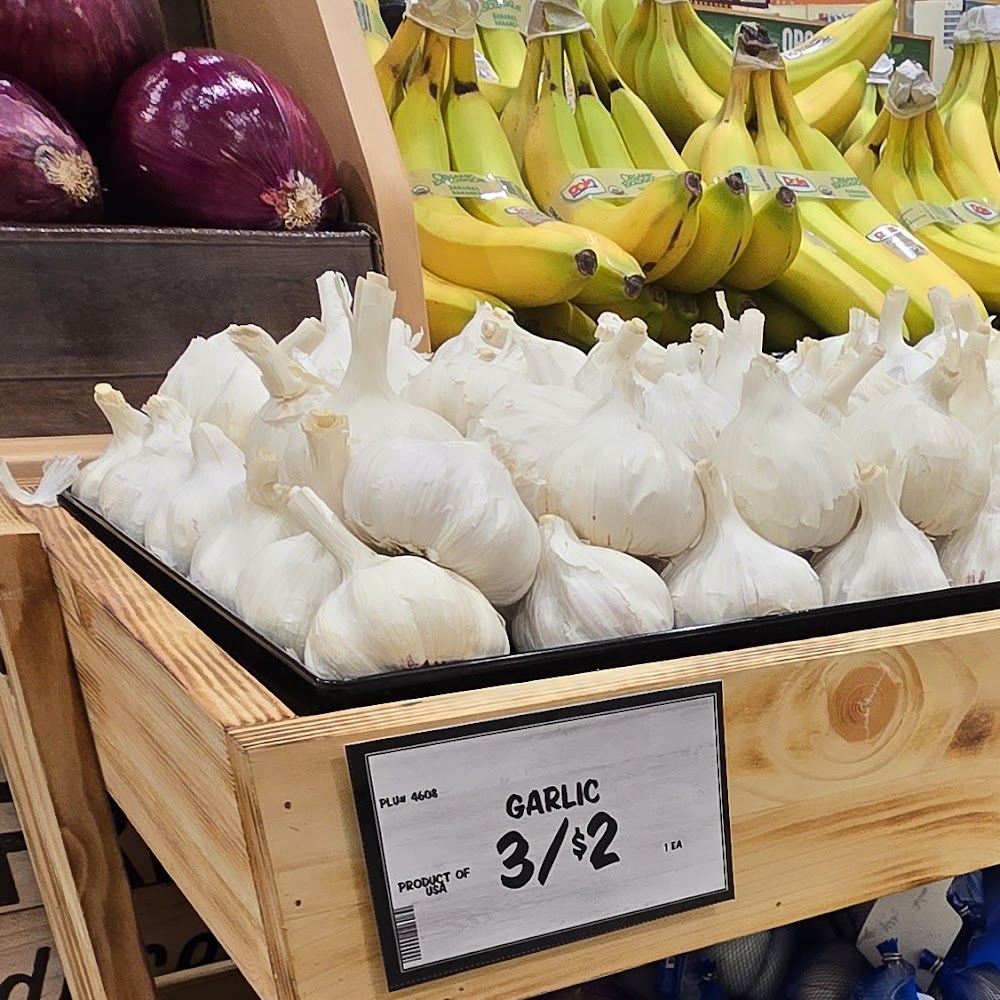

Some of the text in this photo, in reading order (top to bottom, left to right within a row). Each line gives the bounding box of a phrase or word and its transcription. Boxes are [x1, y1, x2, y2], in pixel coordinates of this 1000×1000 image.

[379, 788, 439, 809] PLU# 4608
[505, 778, 601, 819] GARLIC
[670, 840, 683, 851] EA
[398, 867, 471, 893] PRODUCT OF
[425, 881, 448, 897] USA
